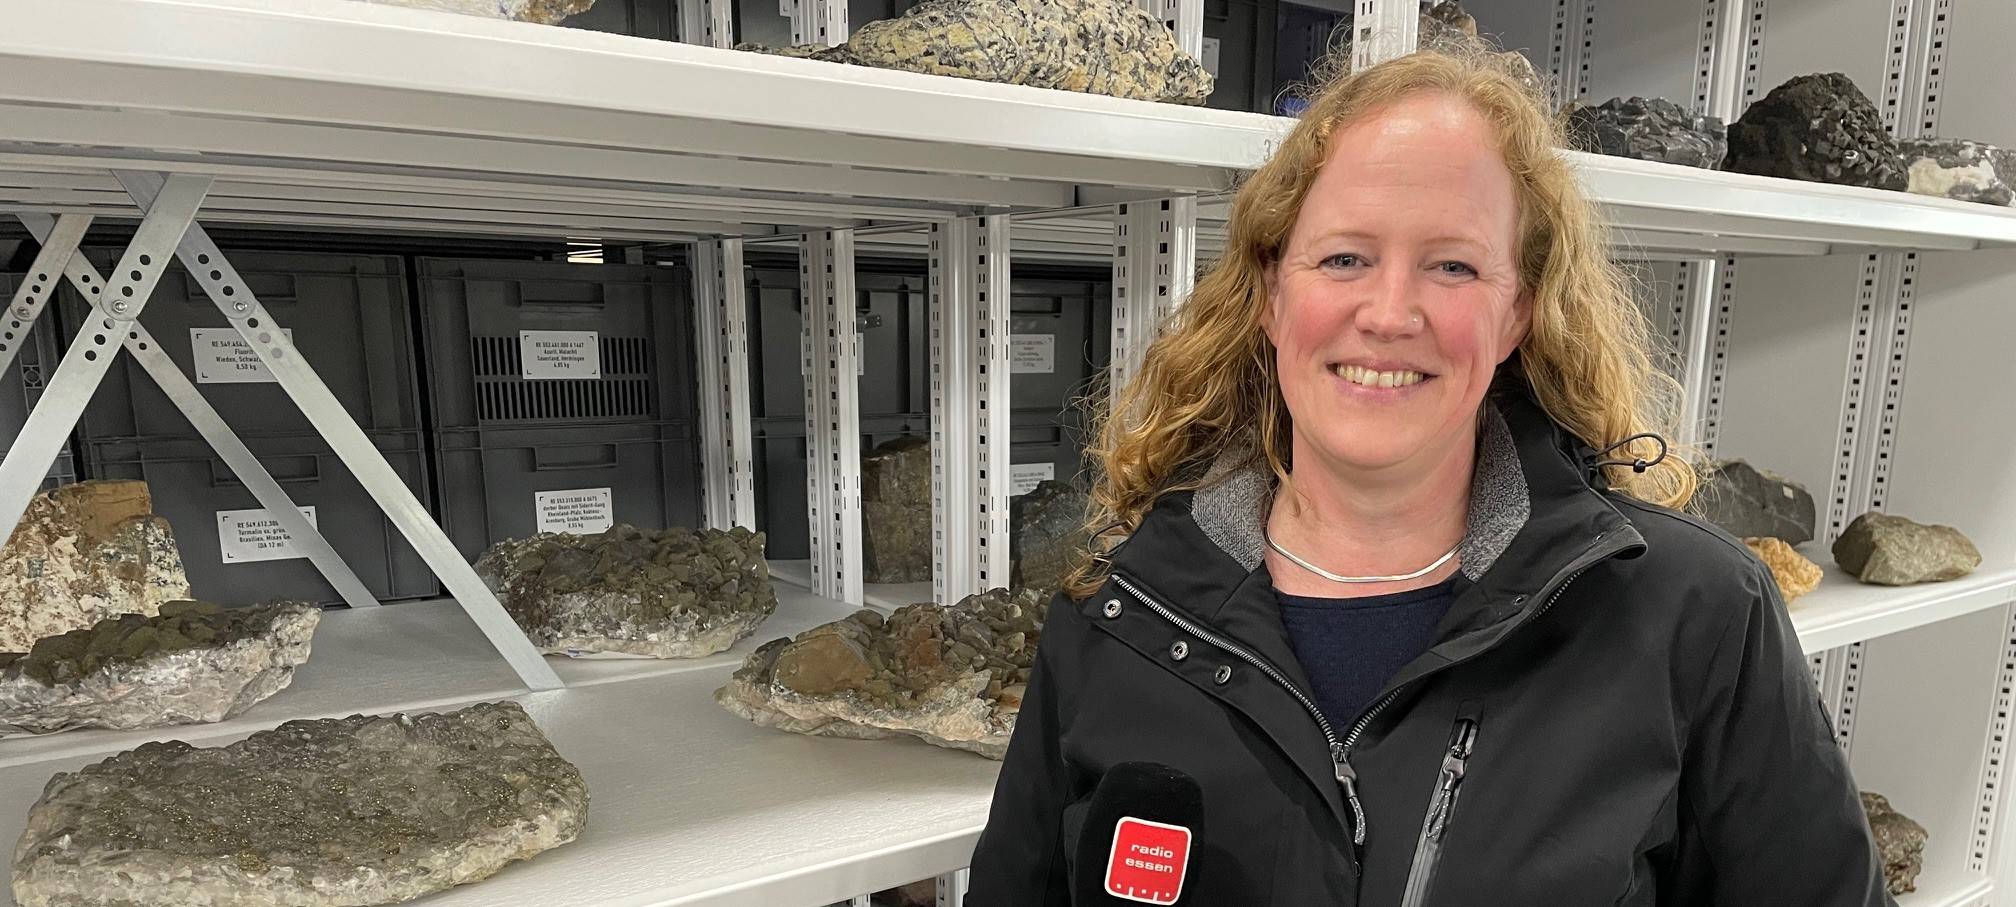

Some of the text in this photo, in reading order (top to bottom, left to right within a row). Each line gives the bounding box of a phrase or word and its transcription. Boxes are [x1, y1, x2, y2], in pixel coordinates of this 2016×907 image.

[249, 363, 257, 371] kg
[1131, 844, 1174, 859] radio
[1125, 857, 1174, 874] essen
